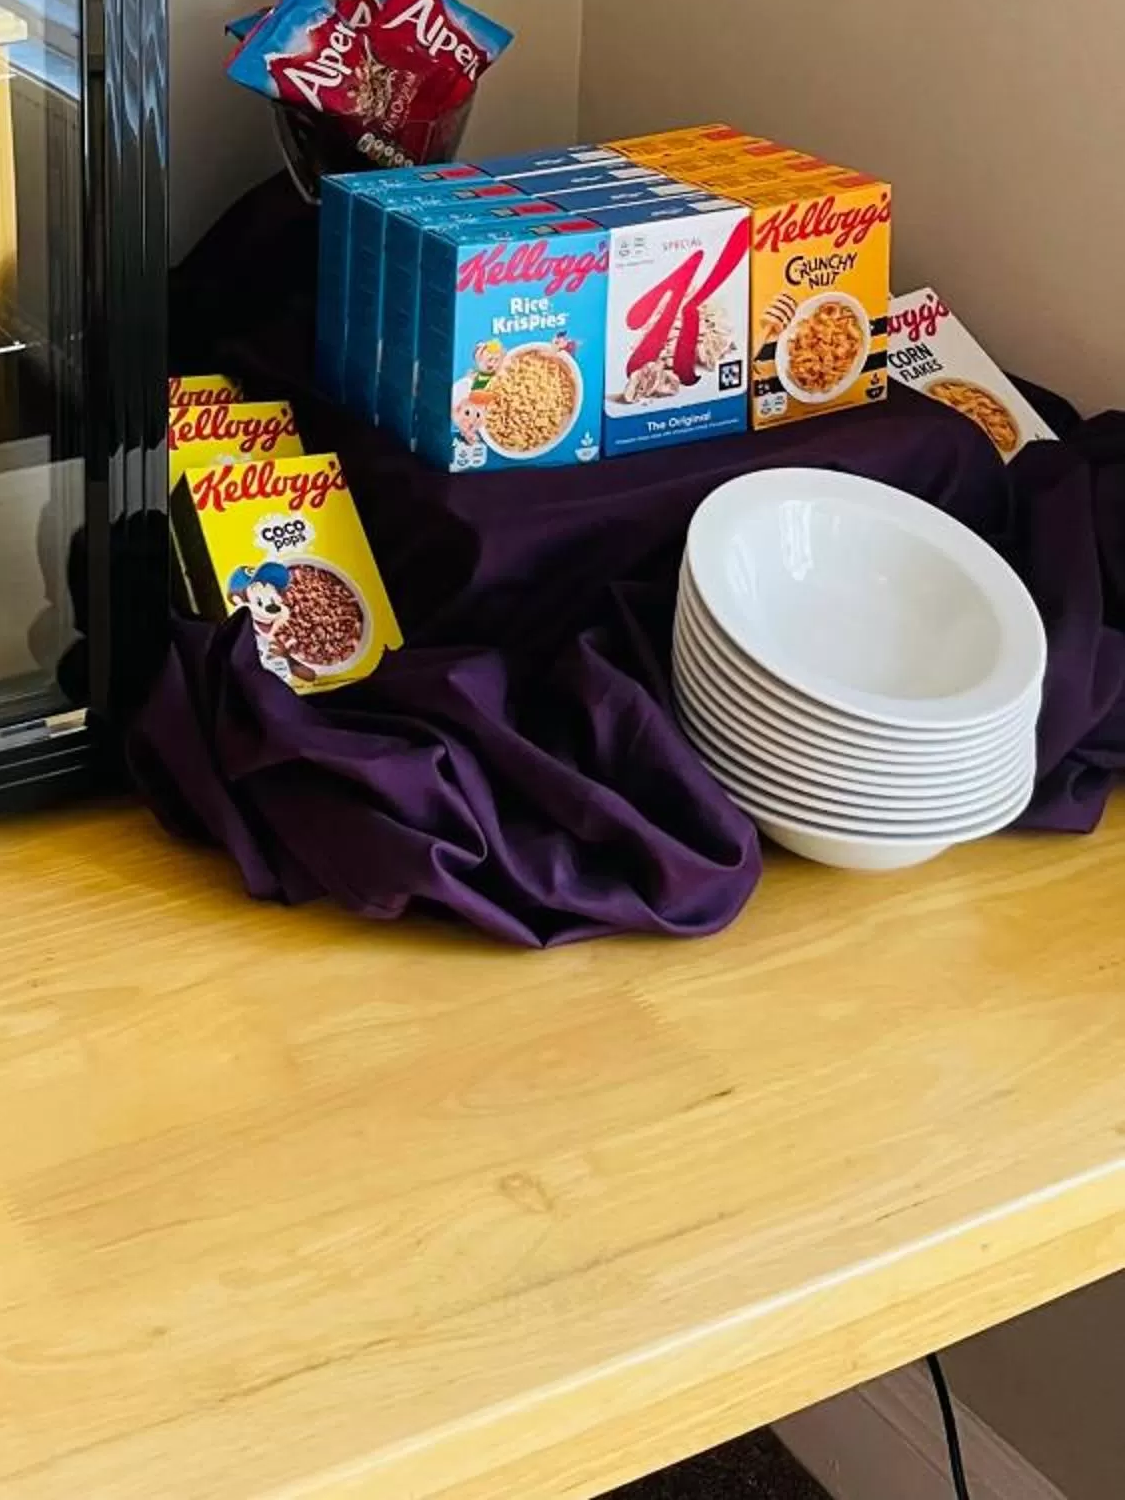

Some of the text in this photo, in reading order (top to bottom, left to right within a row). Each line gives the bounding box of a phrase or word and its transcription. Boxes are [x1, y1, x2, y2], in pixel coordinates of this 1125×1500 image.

[755, 192, 891, 253] Kellogg's
[456, 240, 609, 295] Kellogg's
[785, 252, 858, 286] CRUNCHY
[808, 271, 840, 289] NUT
[510, 297, 550, 315] Rice
[492, 311, 567, 334] Krispies
[888, 343, 934, 369] CORN
[899, 359, 944, 383] FLAKES
[647, 420, 666, 433] The
[668, 408, 712, 427] Original
[193, 460, 348, 512] Kellogg's
[274, 534, 306, 551] pops
